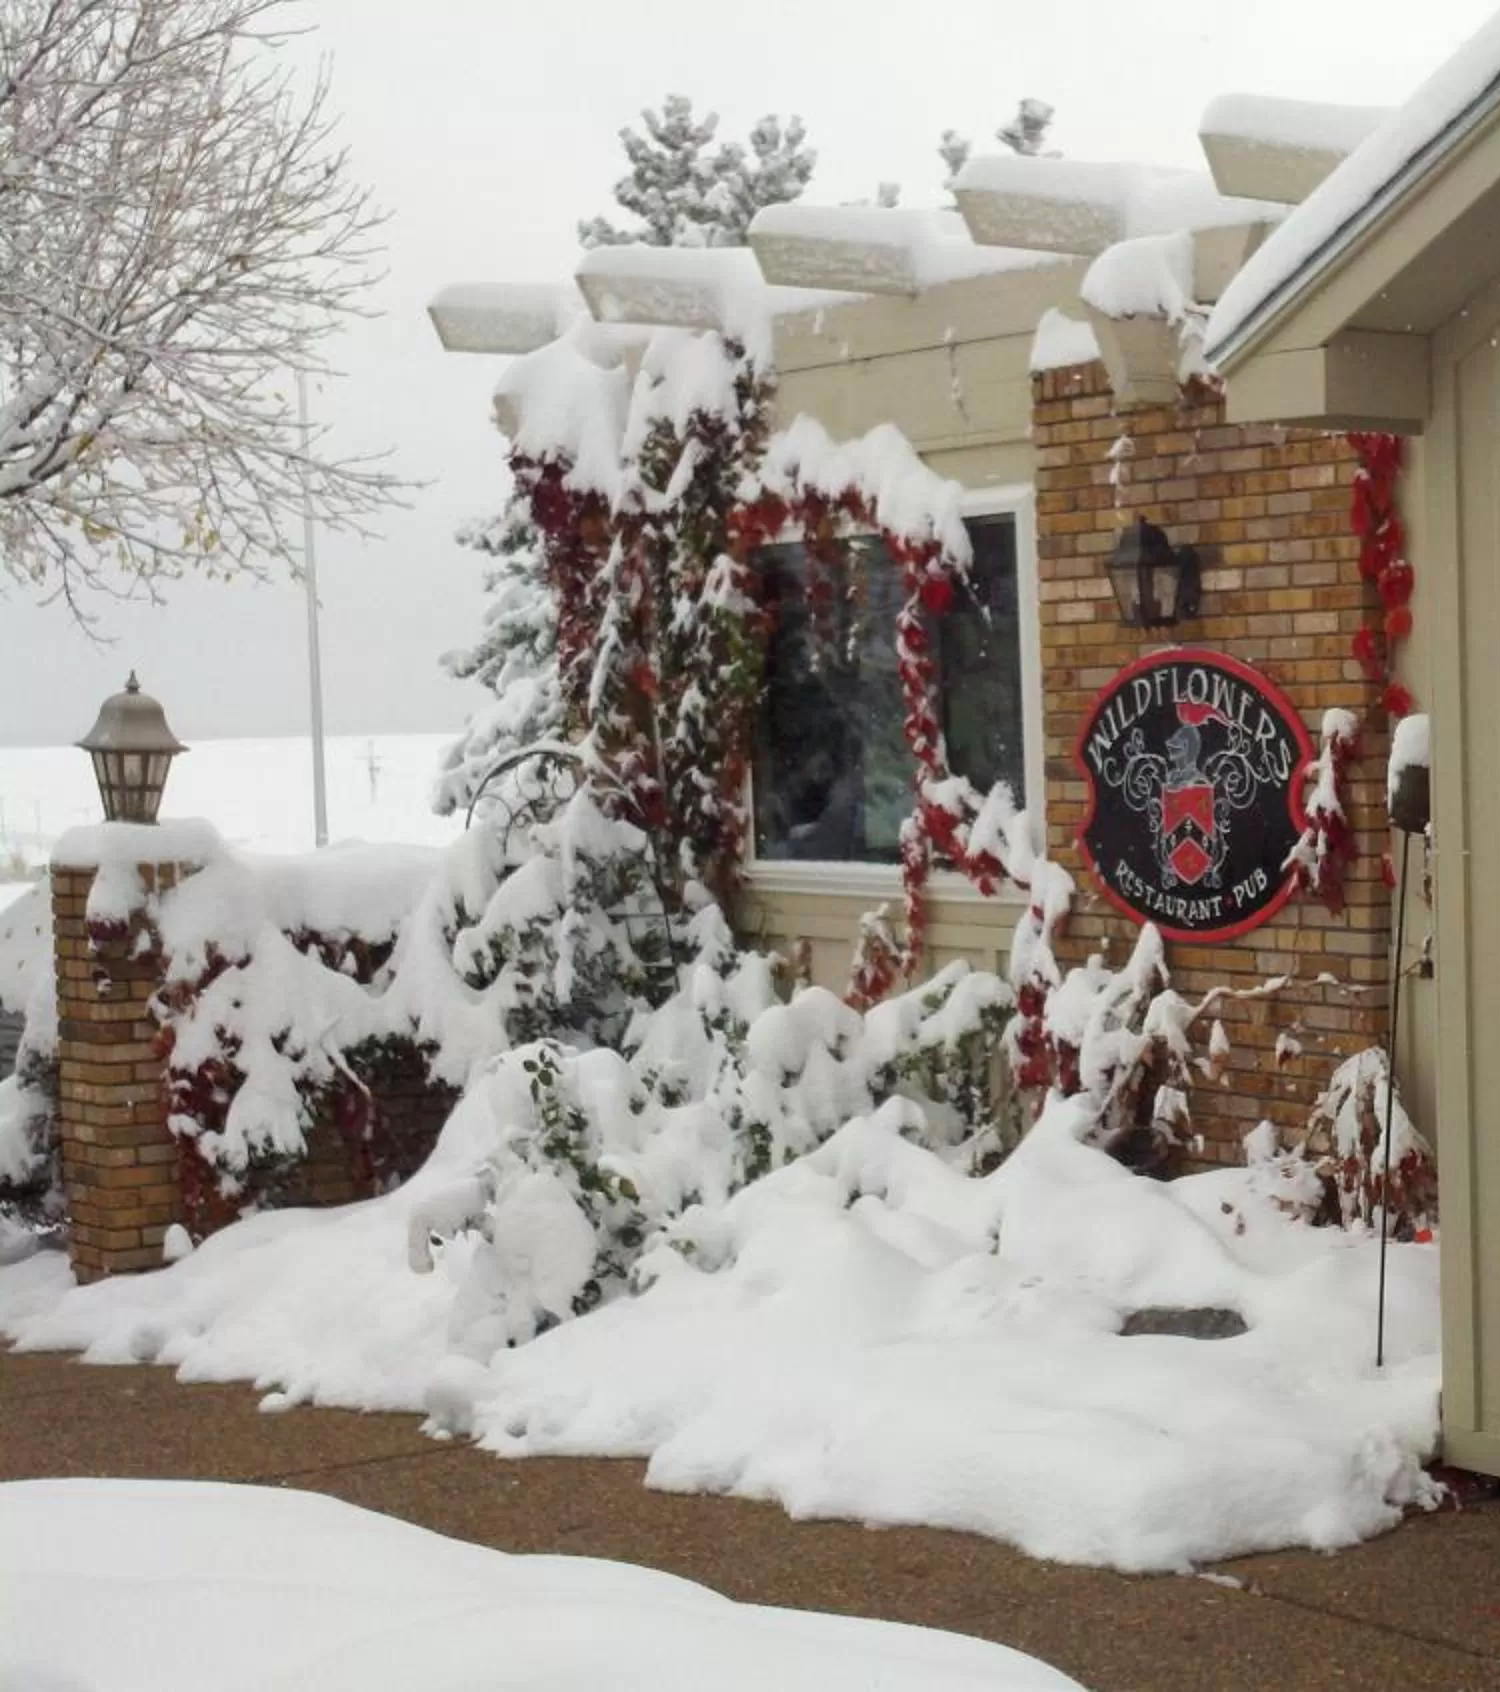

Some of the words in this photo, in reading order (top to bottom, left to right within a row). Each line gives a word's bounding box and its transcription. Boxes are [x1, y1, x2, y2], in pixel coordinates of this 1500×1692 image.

[1087, 668, 1292, 787] WILDFLOWERS
[1115, 859, 1223, 927] RESTAURANT
[1233, 868, 1268, 908] PUB
